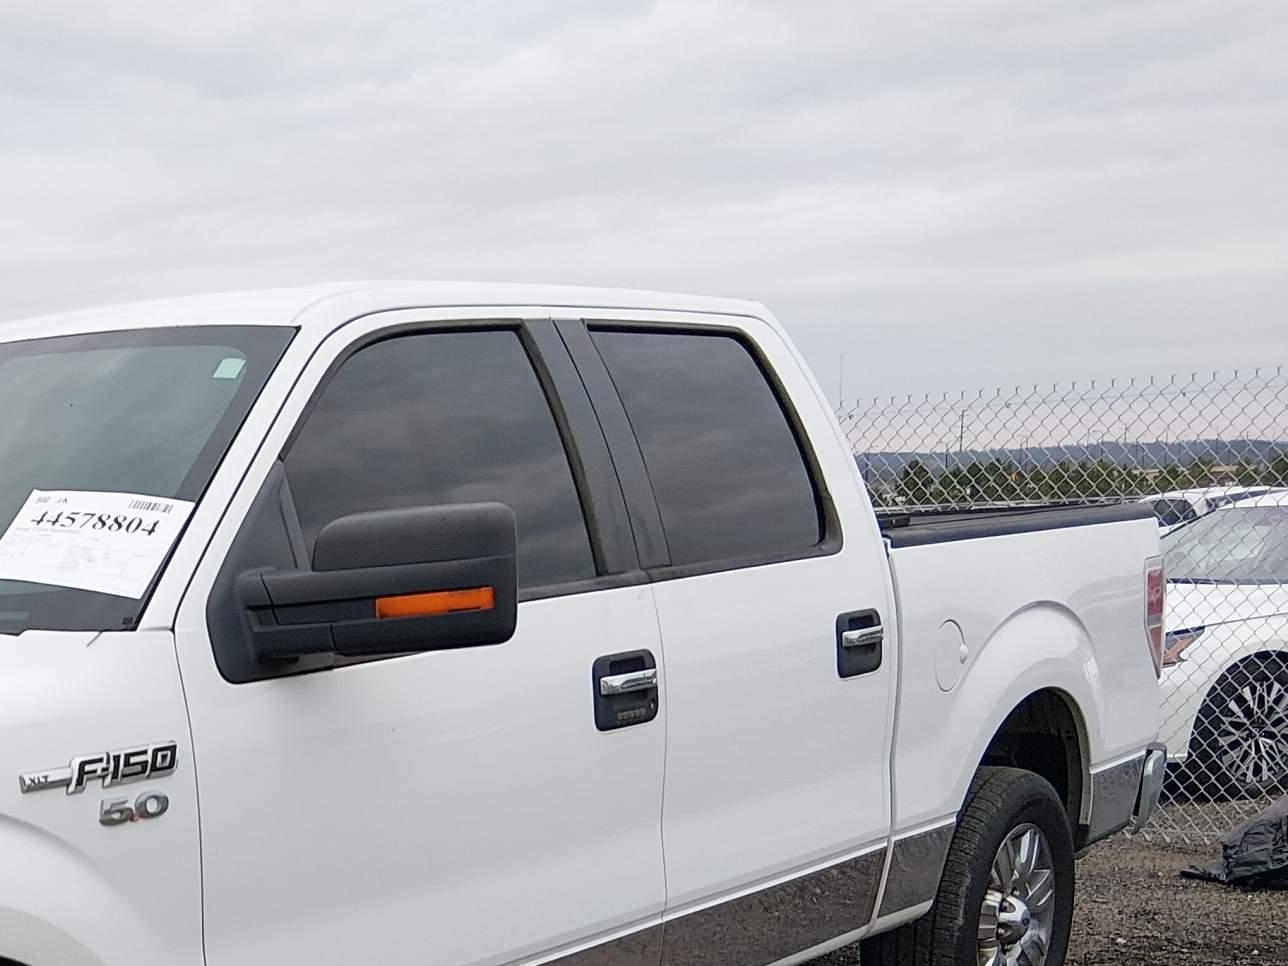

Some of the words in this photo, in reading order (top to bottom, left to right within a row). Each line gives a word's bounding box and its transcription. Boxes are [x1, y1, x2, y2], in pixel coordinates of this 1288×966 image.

[30, 510, 160, 536] 44578804
[28, 774, 50, 786] XLT
[67, 741, 178, 795] F-150
